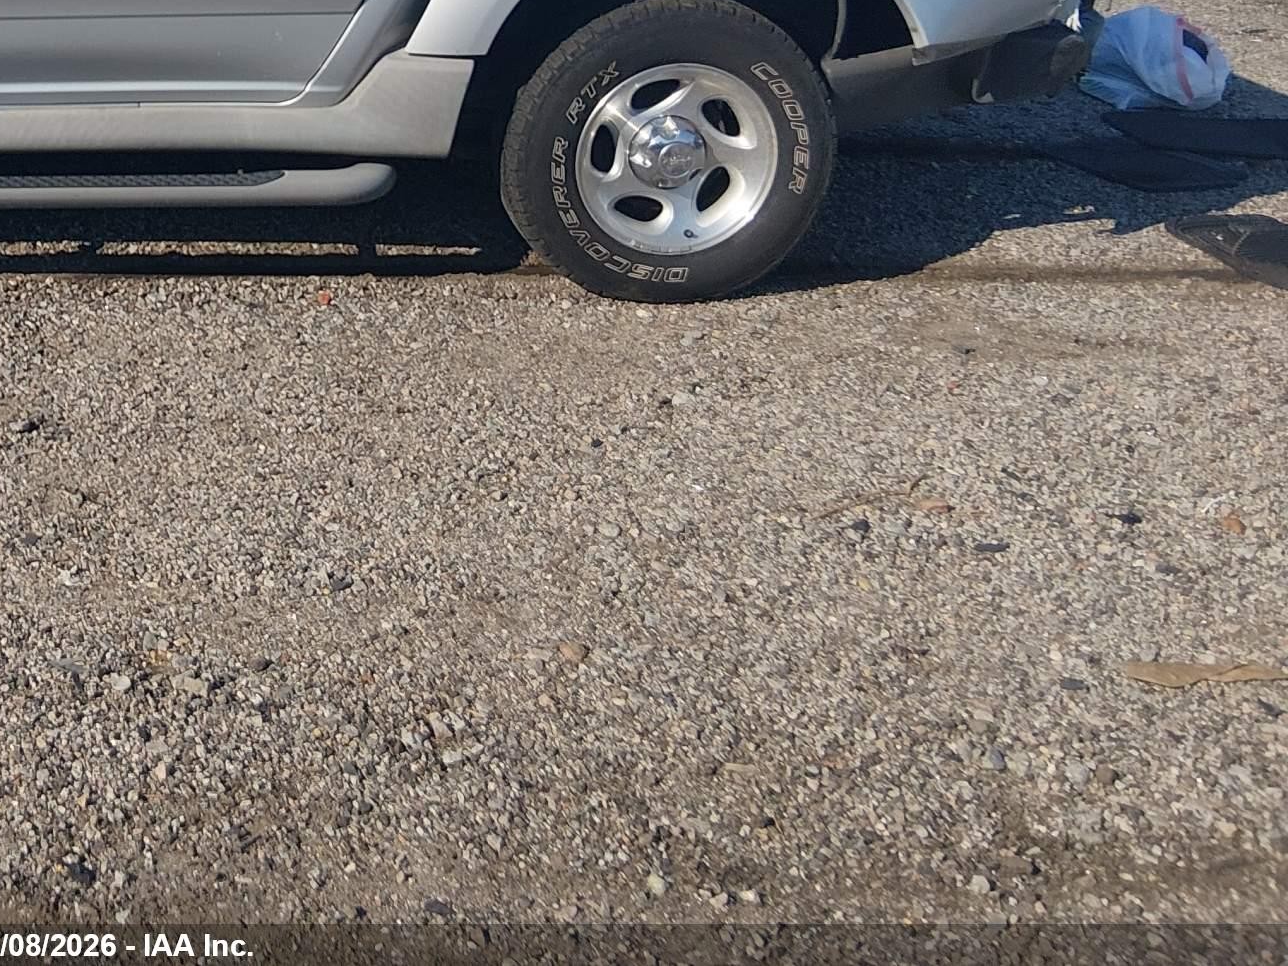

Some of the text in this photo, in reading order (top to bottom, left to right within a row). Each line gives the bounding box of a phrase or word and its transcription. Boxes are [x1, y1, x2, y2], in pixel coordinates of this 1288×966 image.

[550, 61, 689, 283] DISCOVERER RTX
[750, 62, 812, 195] COOPER
